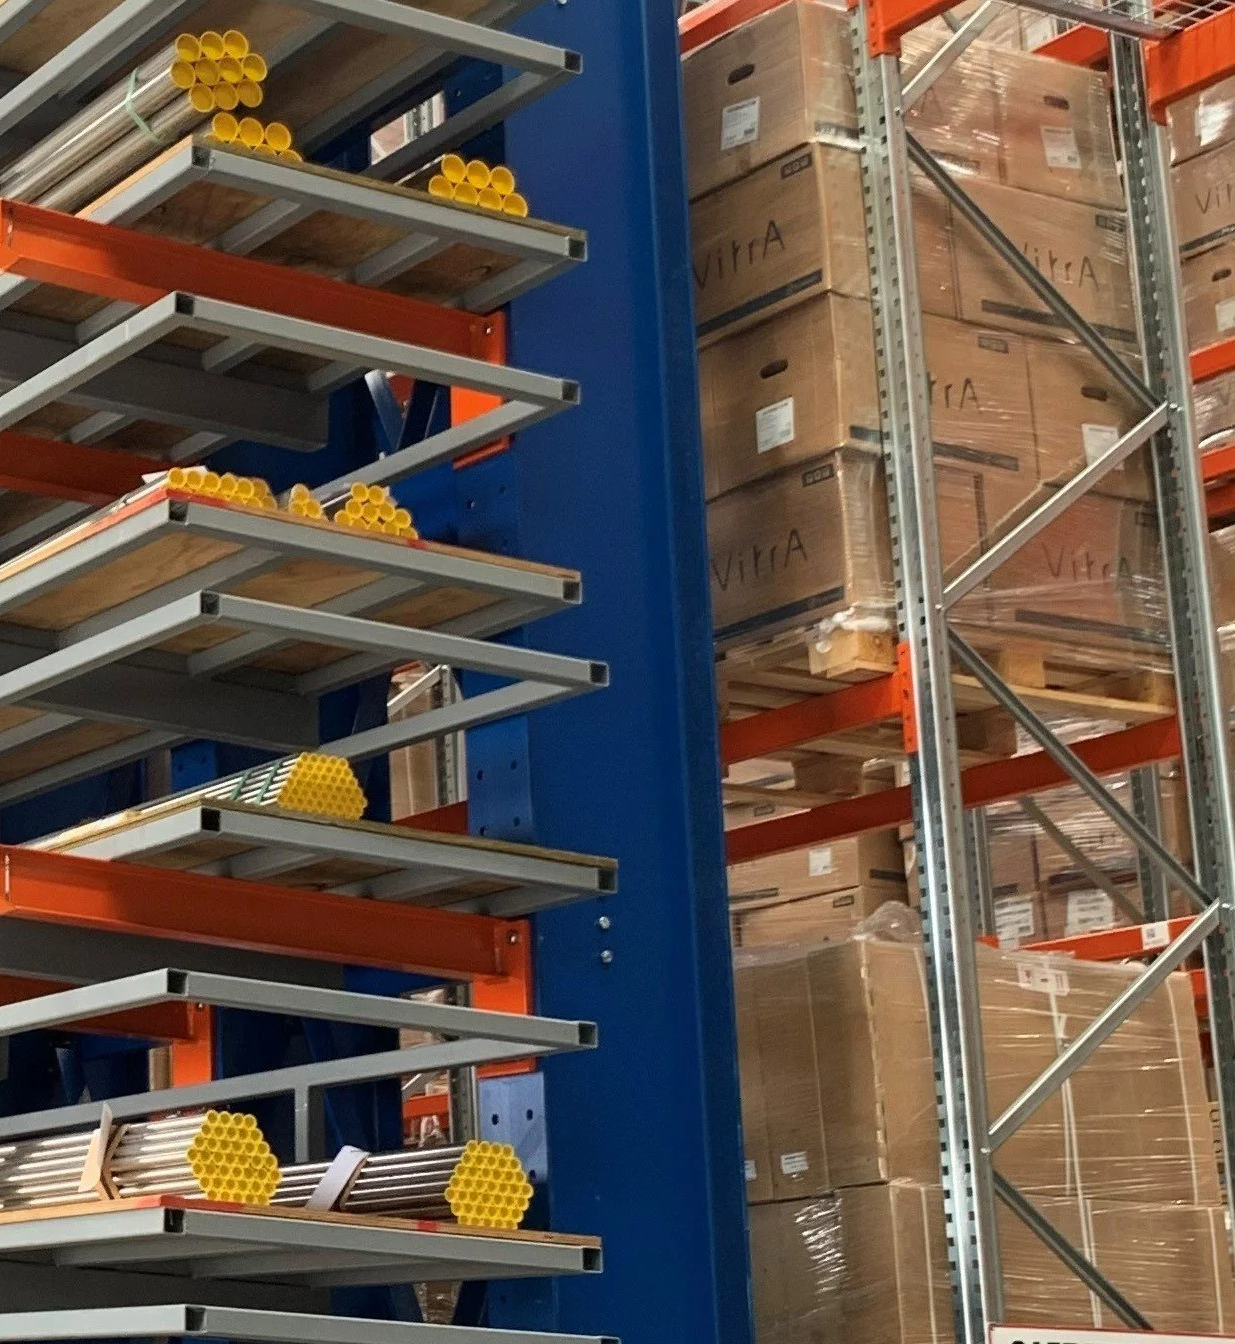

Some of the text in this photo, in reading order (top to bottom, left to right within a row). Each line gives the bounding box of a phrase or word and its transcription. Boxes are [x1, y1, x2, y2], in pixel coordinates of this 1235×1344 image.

[693, 219, 786, 290] VitrA
[1024, 242, 1100, 291] itrA
[925, 371, 982, 414] trA
[711, 528, 808, 592] VitrA
[1042, 543, 1132, 583] VitrA
